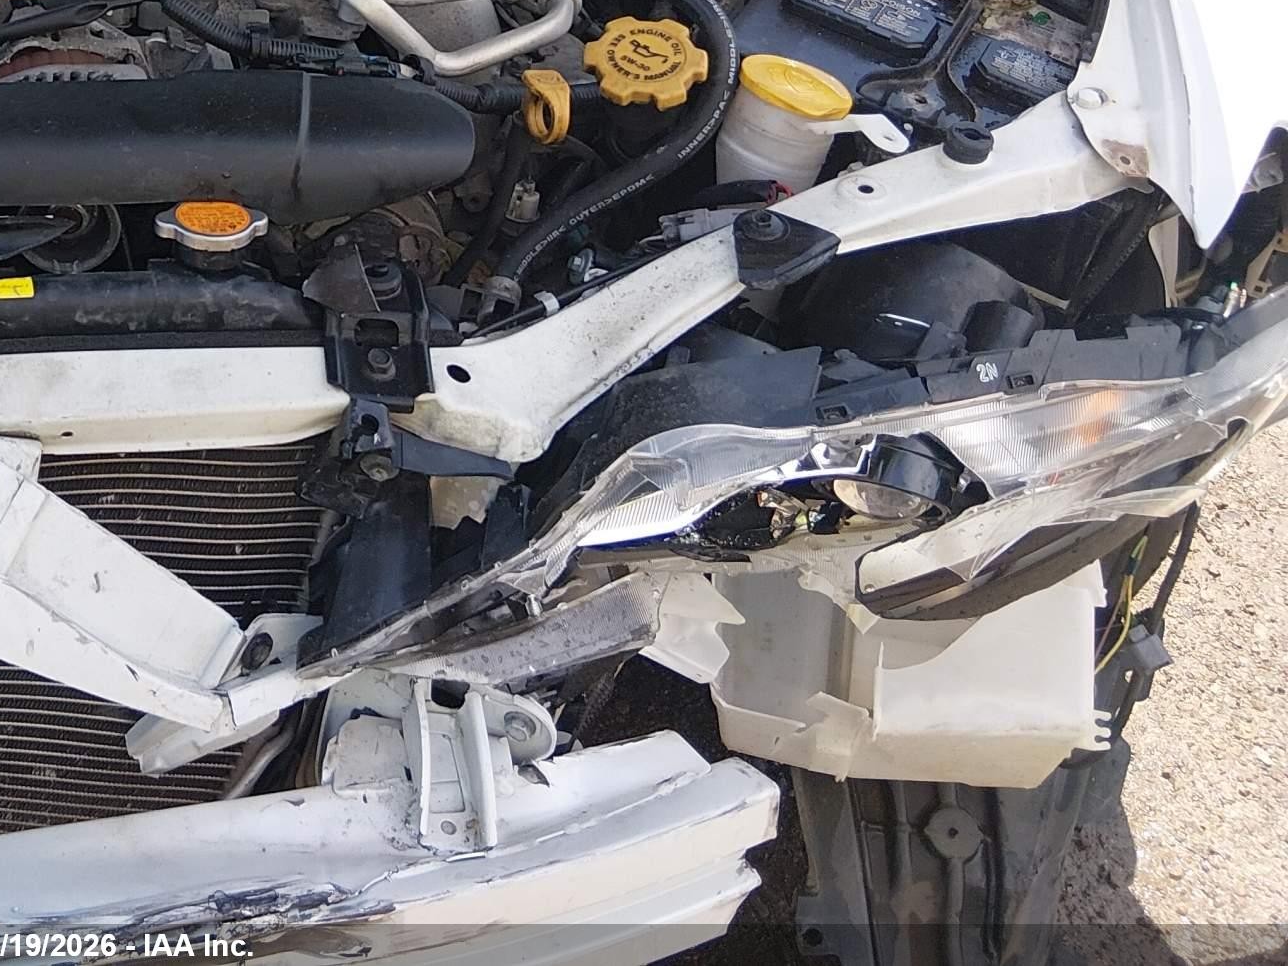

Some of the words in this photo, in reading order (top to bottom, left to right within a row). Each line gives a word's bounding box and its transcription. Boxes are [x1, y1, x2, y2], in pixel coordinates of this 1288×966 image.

[610, 33, 627, 48] SEE
[630, 27, 673, 43] ENGINE
[671, 42, 682, 56] OIL
[606, 49, 641, 80] OWNER'S
[619, 54, 651, 72] 5W-30
[643, 60, 682, 81] MANUAL
